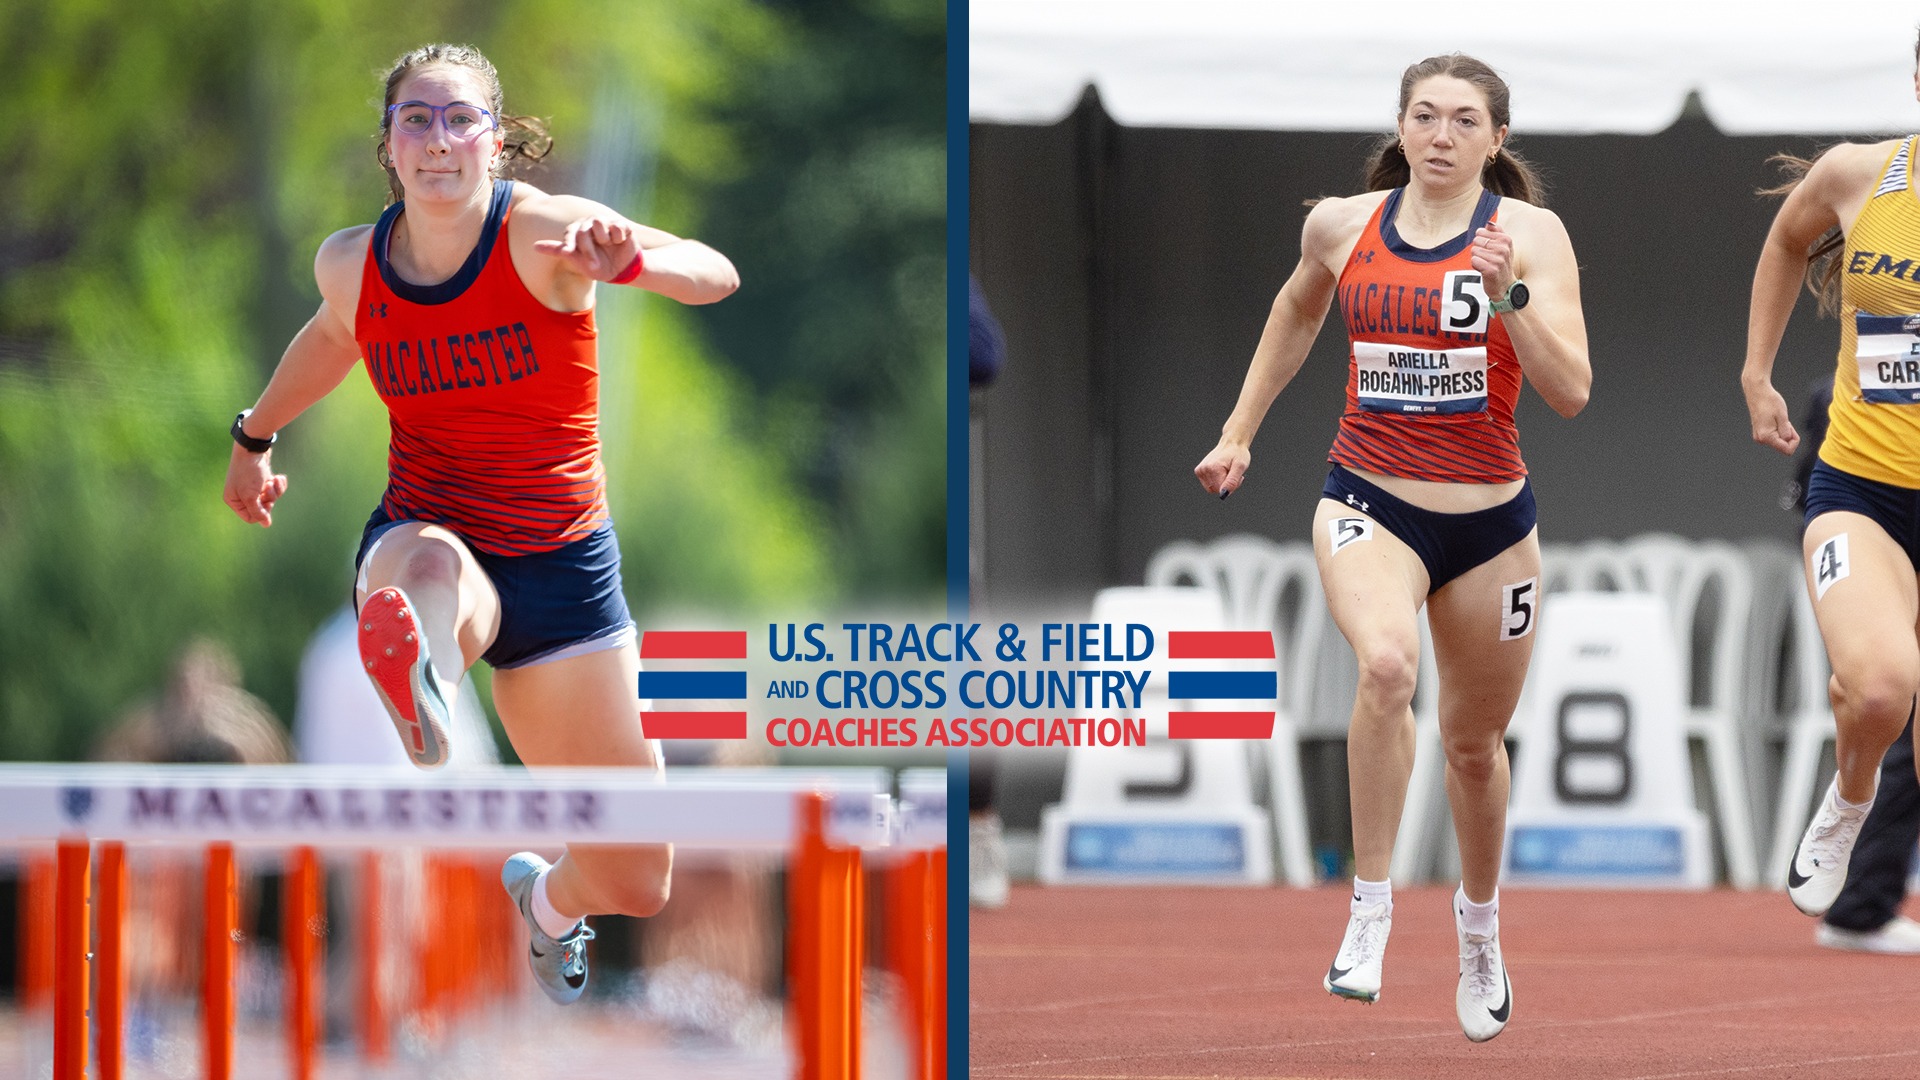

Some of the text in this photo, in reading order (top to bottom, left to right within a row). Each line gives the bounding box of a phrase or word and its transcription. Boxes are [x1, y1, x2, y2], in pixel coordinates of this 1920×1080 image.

[1340, 282, 1488, 343] MACALES
[1450, 275, 1481, 328] 5
[368, 321, 540, 397] MACALESTER
[1360, 370, 1485, 397] ROGAHN-PRESS
[1388, 351, 1450, 370] ARIELLA
[1337, 518, 1365, 548] 5
[1819, 540, 1842, 585] 4
[1508, 582, 1533, 637] 5
[1555, 690, 1633, 804] 8
[129, 786, 606, 831] MACALESTER
